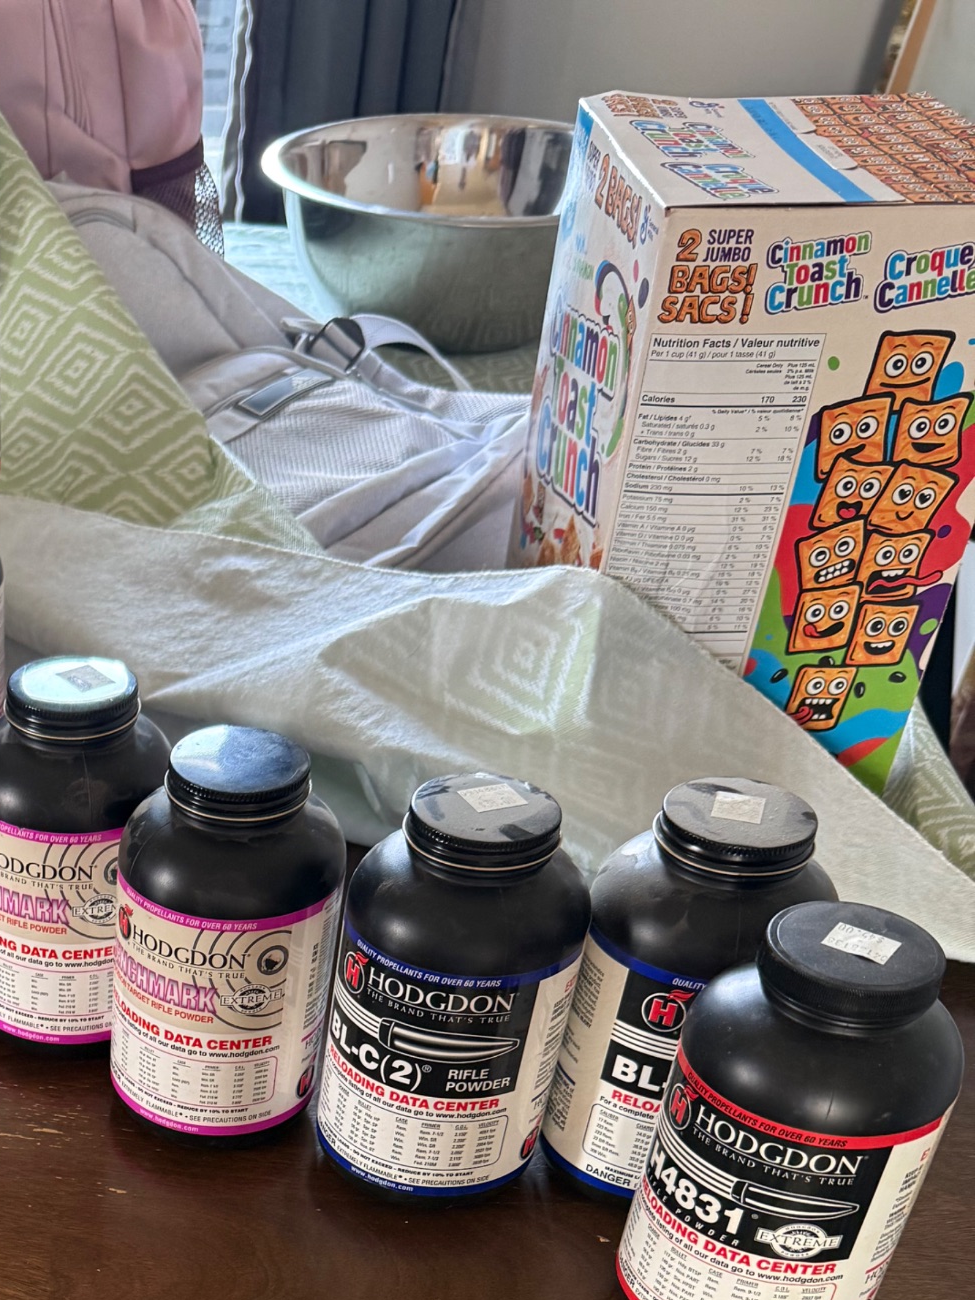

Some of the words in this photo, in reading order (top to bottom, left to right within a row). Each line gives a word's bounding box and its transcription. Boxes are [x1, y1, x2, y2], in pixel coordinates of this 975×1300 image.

[676, 229, 702, 262] 2
[707, 229, 754, 245] SUPER
[769, 232, 870, 264] Cinnamon
[702, 246, 751, 262] JUMBO
[888, 244, 974, 281] Croque
[668, 263, 758, 294] BAGS!
[784, 257, 847, 286] Toast
[768, 273, 861, 312] Crunch
[653, 338, 699, 348] Nutrition
[703, 339, 731, 348] Facts
[741, 338, 773, 348] Valeur
[776, 338, 820, 348] nutritive
[642, 395, 675, 403] Calories
[21, 943, 58, 960] DATA
[61, 945, 115, 960] CENTE
[132, 924, 246, 969] HODGDON
[114, 937, 218, 1015] ENCHMARK
[357, 939, 377, 958] QUALITY
[377, 954, 423, 978] PROPELLANTS
[424, 974, 439, 983] FOR
[441, 977, 462, 986] OVER
[464, 979, 474, 987] 60
[368, 967, 513, 1013] HODGDON
[163, 1029, 203, 1048] DATA
[206, 1036, 272, 1049] CENTER
[331, 1010, 421, 1091] BL-C(2)
[446, 1078, 510, 1092] POWDER
[448, 1069, 489, 1079] RIFLE
[389, 1091, 429, 1108] DATA
[433, 1099, 499, 1111] CENTER
[695, 1105, 861, 1176] HODGDON
[586, 1164, 630, 1187] DANGER
[650, 1138, 744, 1235] H4831
[703, 1238, 750, 1267] DATA
[756, 1259, 836, 1275] CENTER
